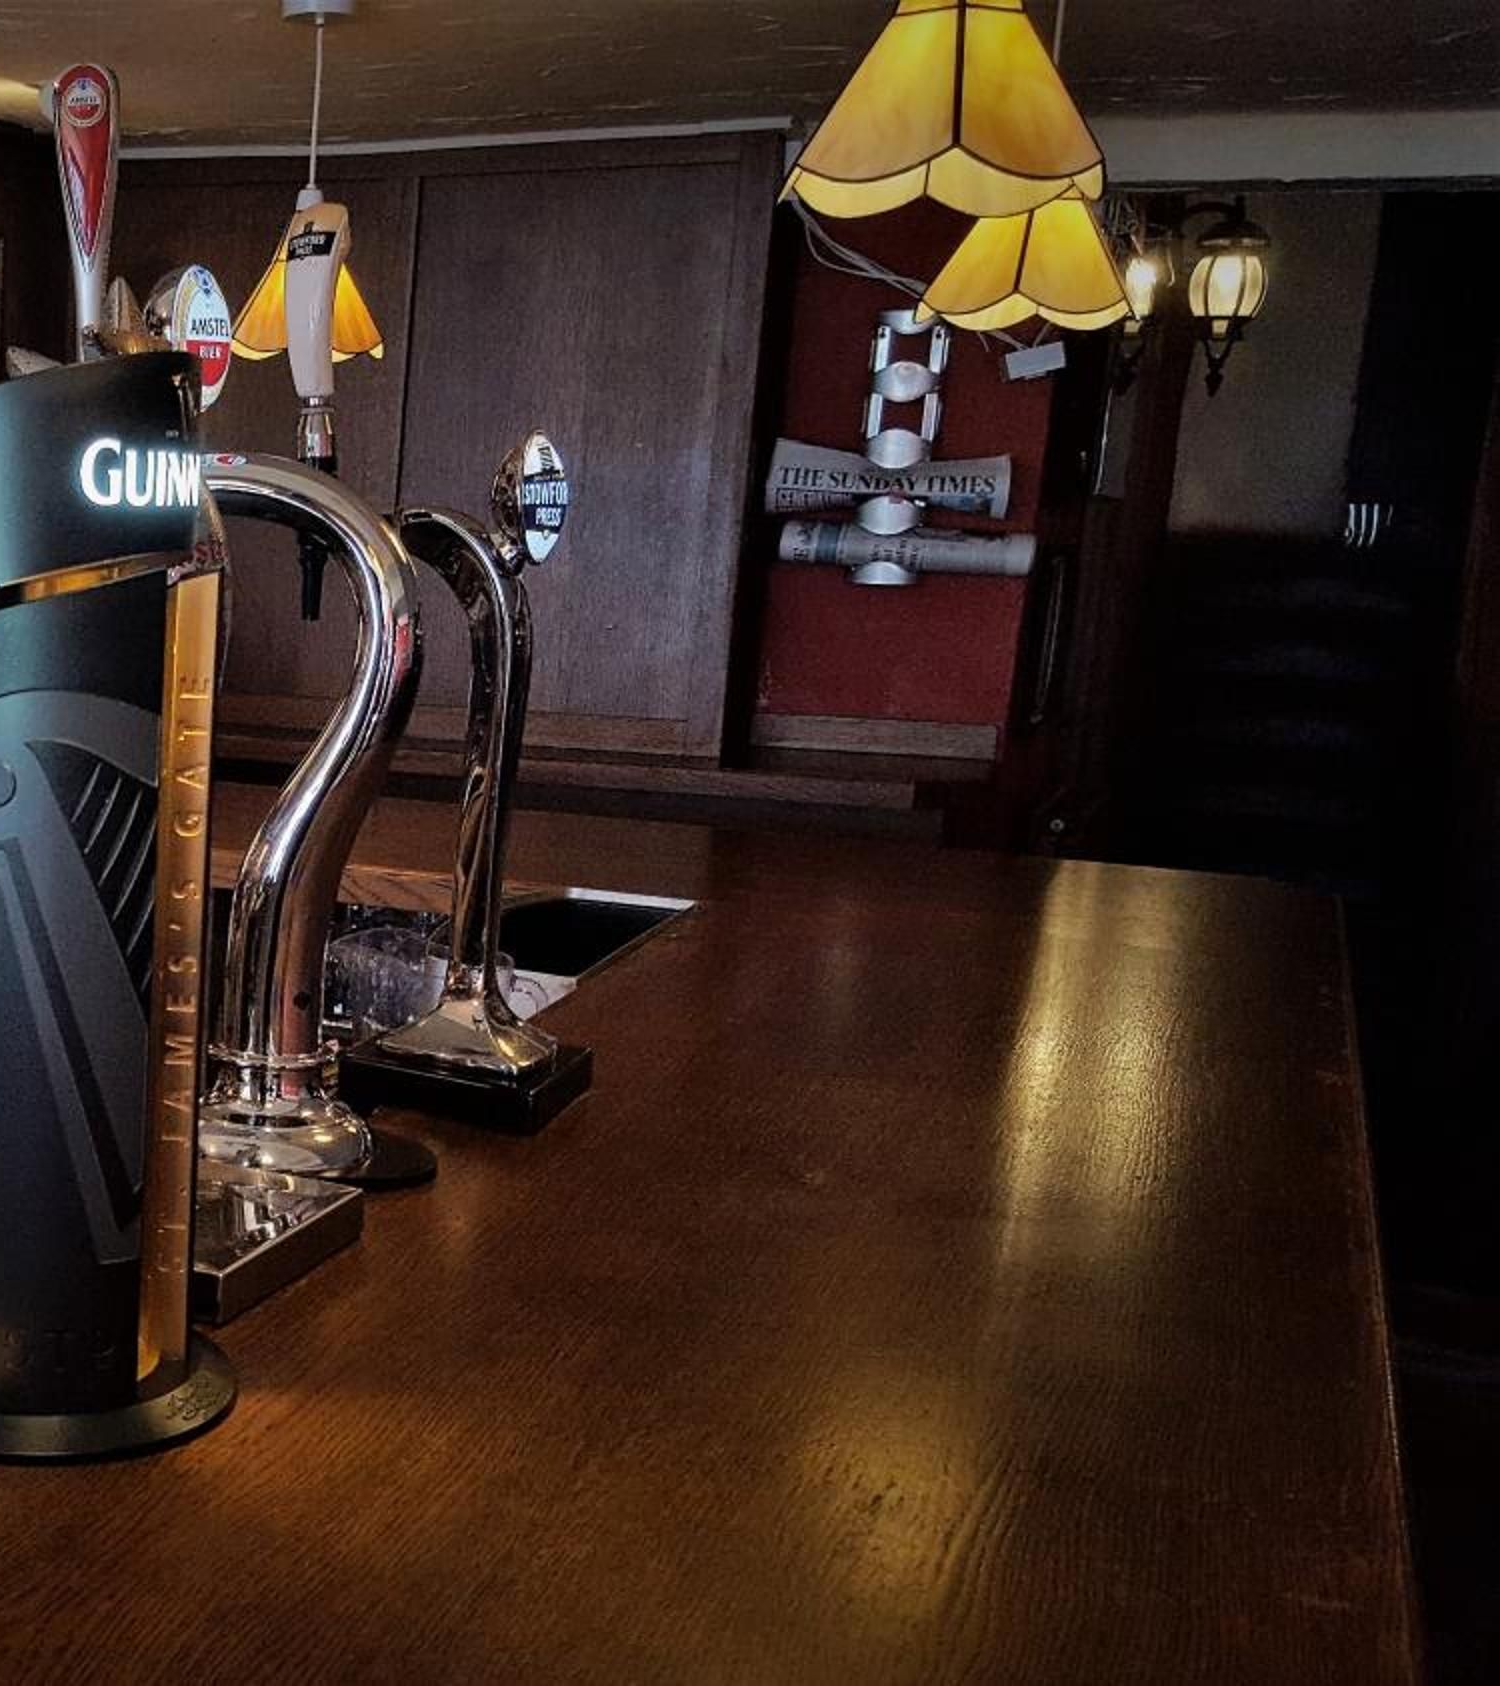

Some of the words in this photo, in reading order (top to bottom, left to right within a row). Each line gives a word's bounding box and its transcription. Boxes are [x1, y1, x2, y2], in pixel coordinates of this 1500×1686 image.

[190, 318, 229, 337] AMSTEL
[780, 467, 824, 487] THE
[830, 471, 918, 493] SUNDAY
[926, 475, 997, 495] TIMES
[535, 507, 561, 527] PRESS
[174, 676, 210, 838] GATE
